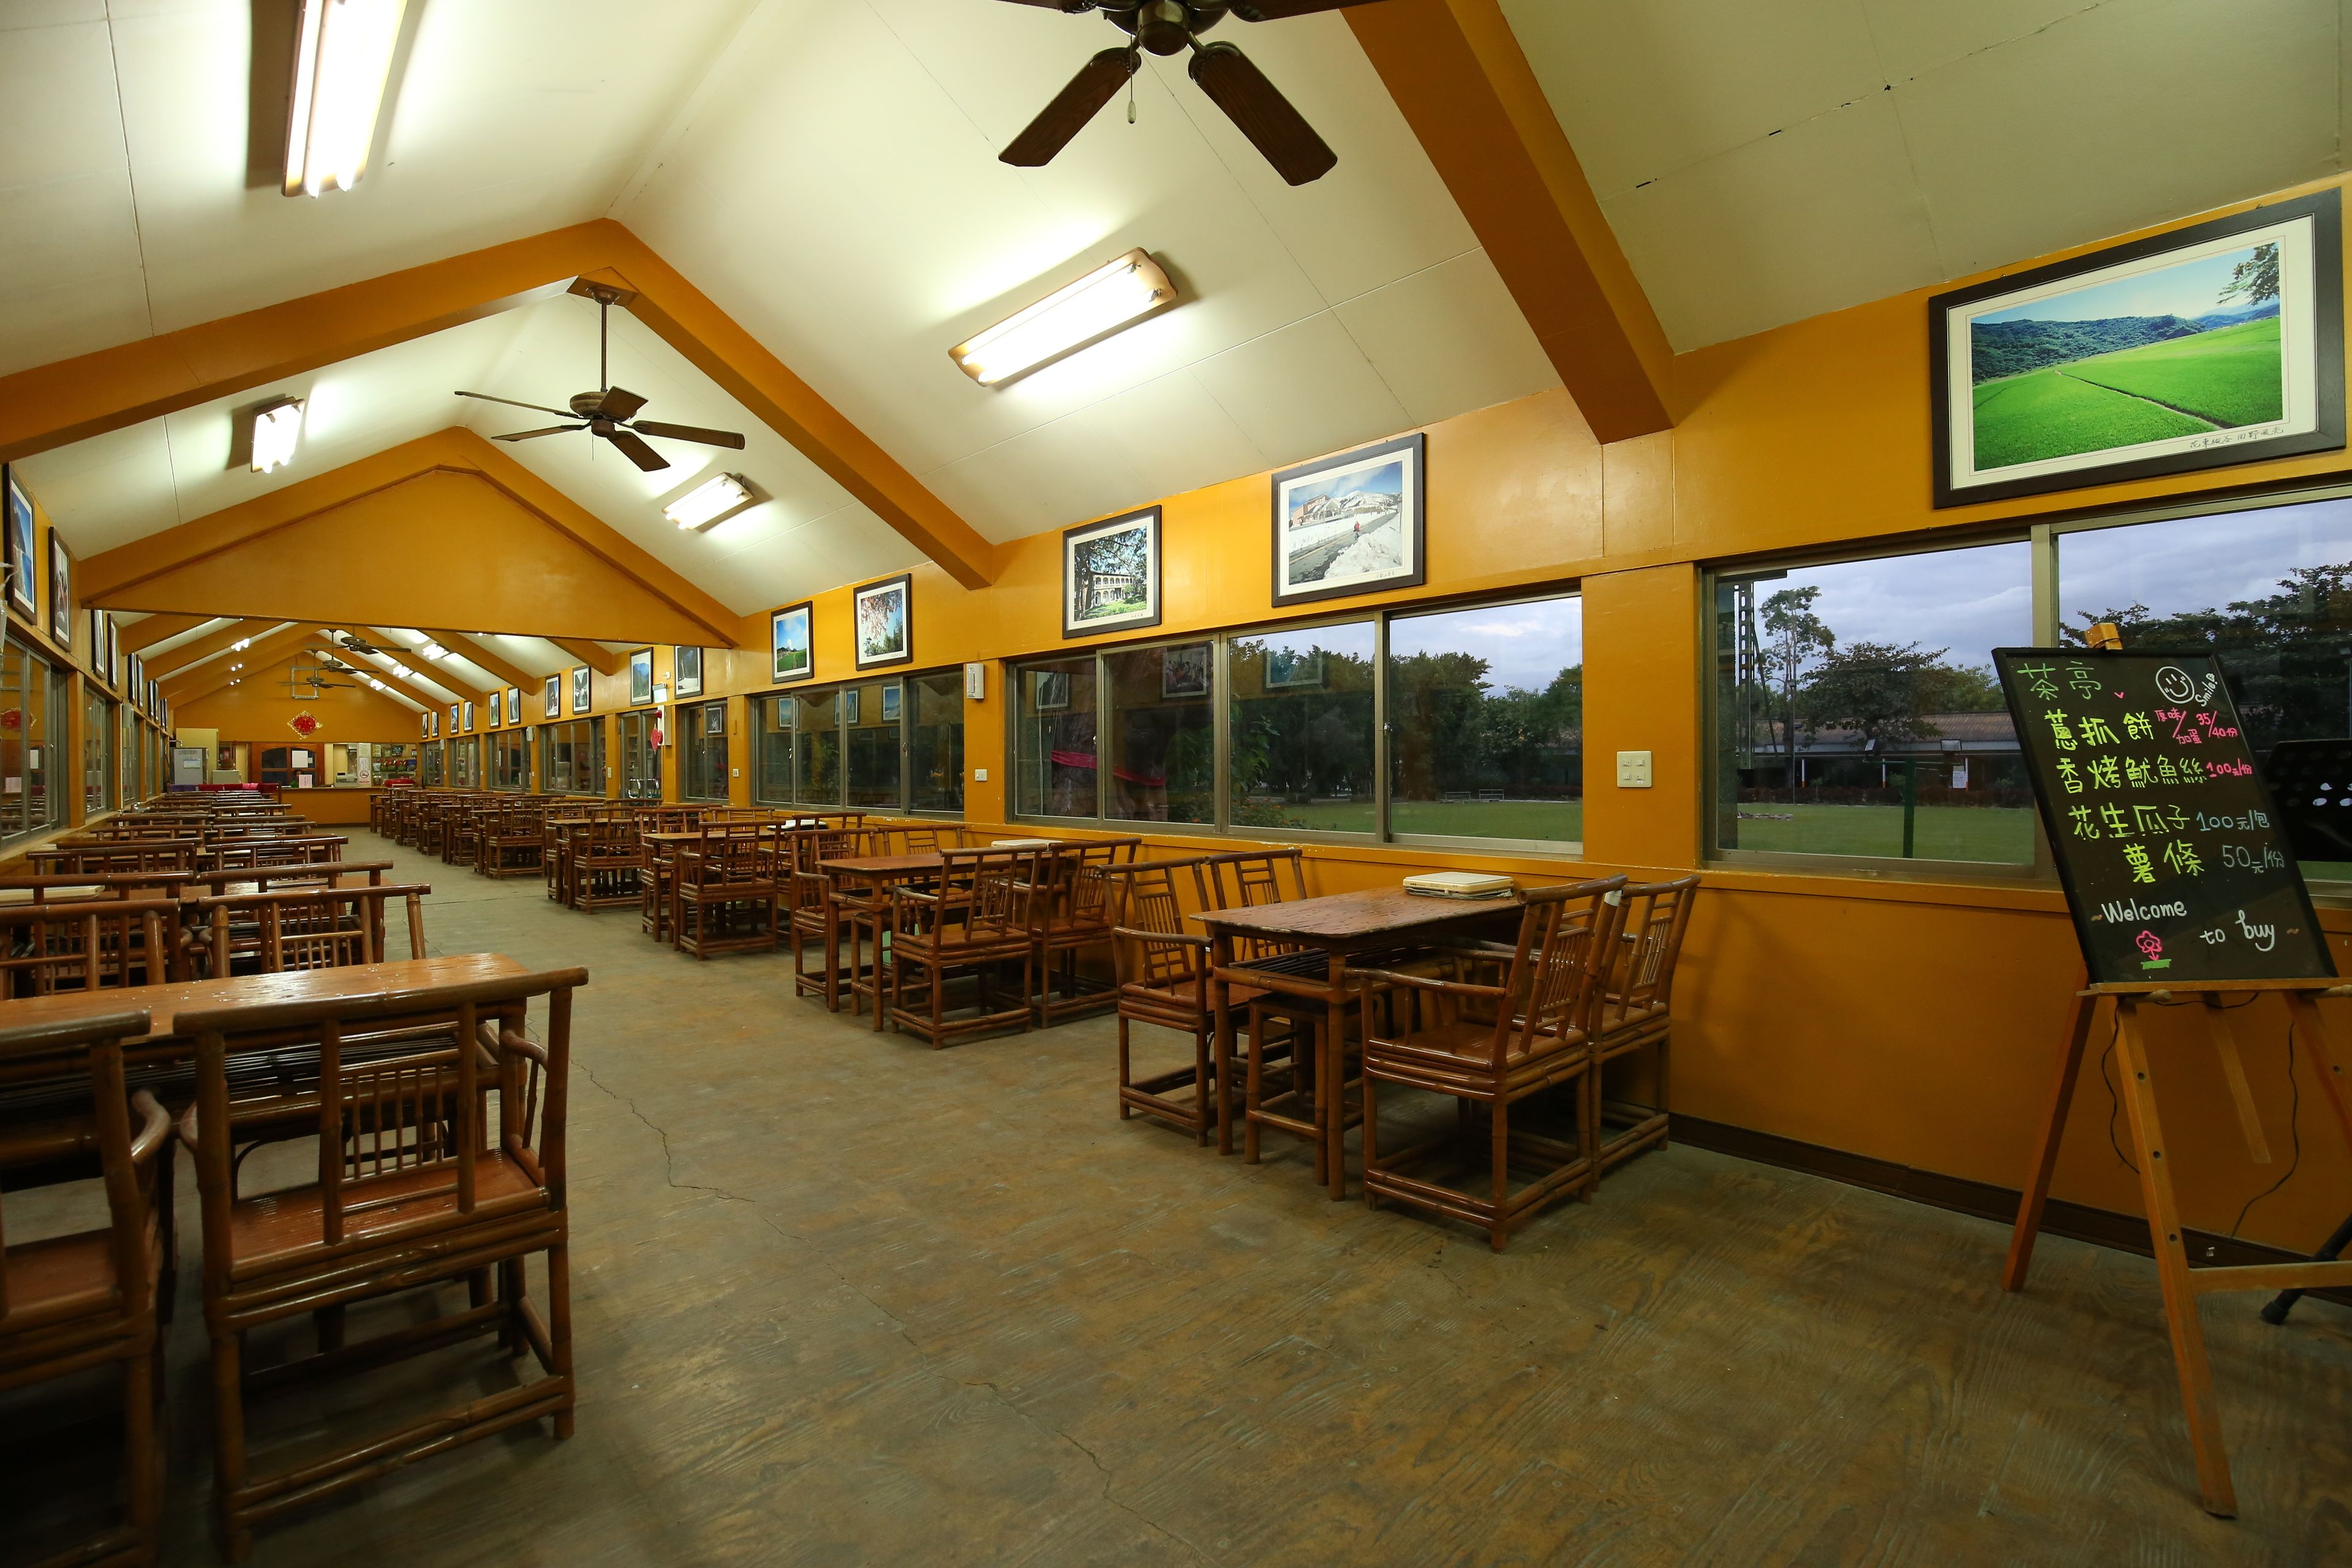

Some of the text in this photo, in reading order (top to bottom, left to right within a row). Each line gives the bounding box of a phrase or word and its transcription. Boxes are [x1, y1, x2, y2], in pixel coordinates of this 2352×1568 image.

[2017, 661, 2102, 701] 茶亭
[2044, 708, 2154, 751] 蔥抓餅
[2056, 755, 2207, 794] 香烤魷魚絲
[2068, 802, 2270, 840] 花生瓜子 100元/包
[2122, 839, 2285, 883] 薯條 50元/份
[2101, 898, 2188, 924] Welcome
[2199, 910, 2275, 952] to buy
